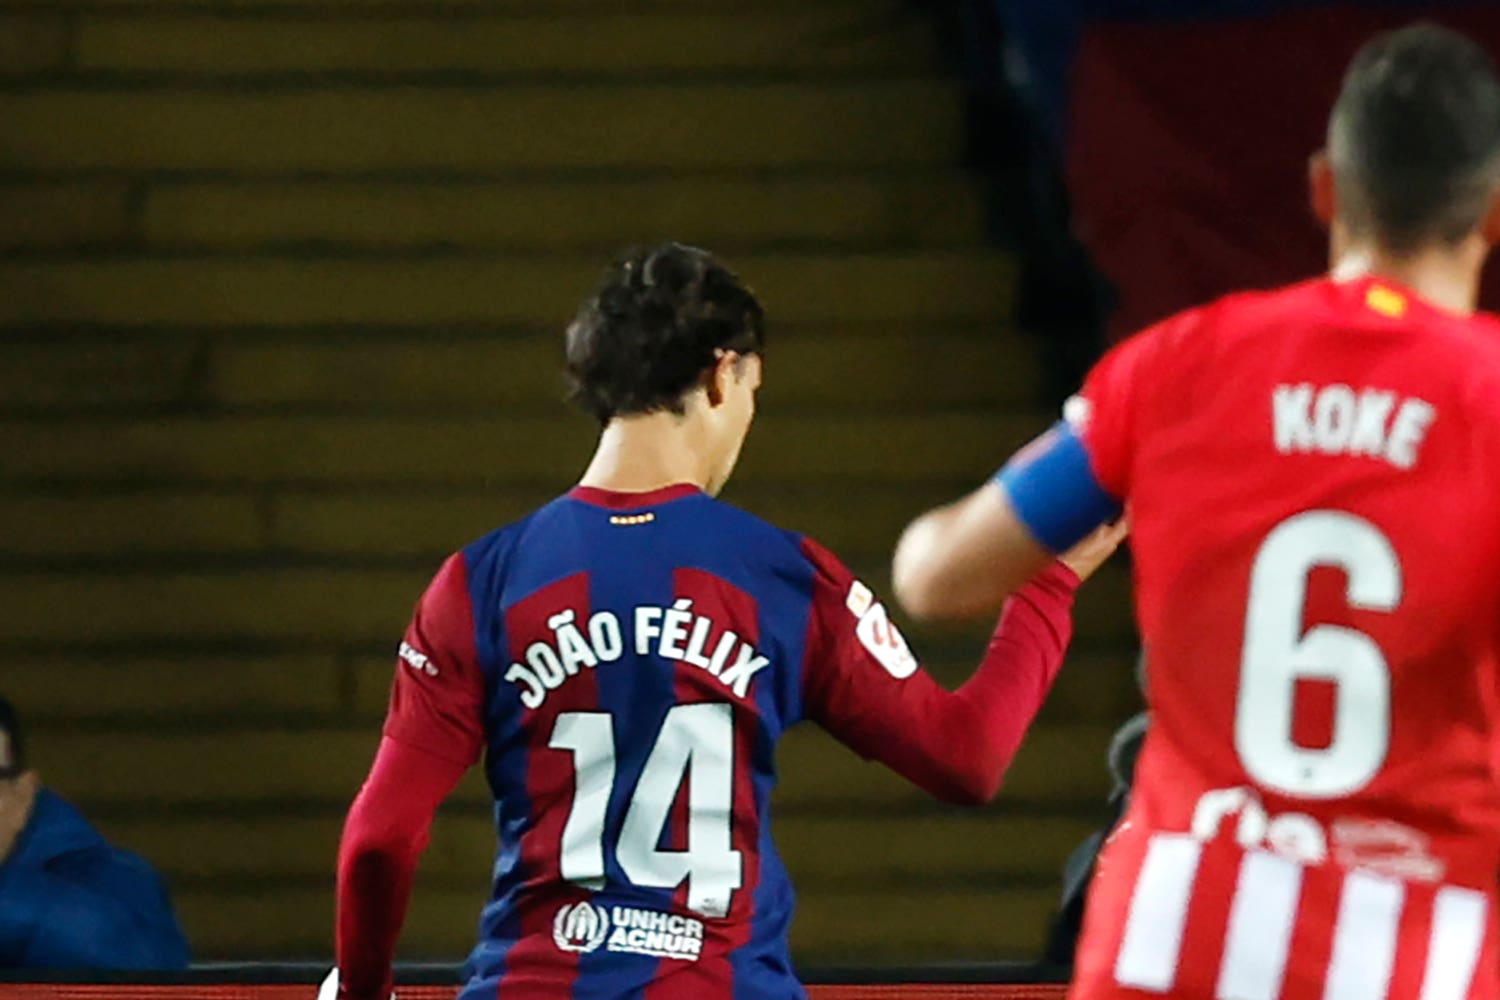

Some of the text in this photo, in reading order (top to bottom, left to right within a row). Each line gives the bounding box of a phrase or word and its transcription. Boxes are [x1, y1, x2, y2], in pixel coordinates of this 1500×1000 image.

[1271, 383, 1438, 470] KOKE
[505, 598, 769, 709] JOÃO FÉLIX
[1233, 508, 1403, 800] 6
[548, 702, 742, 918] 14
[607, 926, 703, 954] ACNUR
[612, 906, 703, 939] UNHCR
